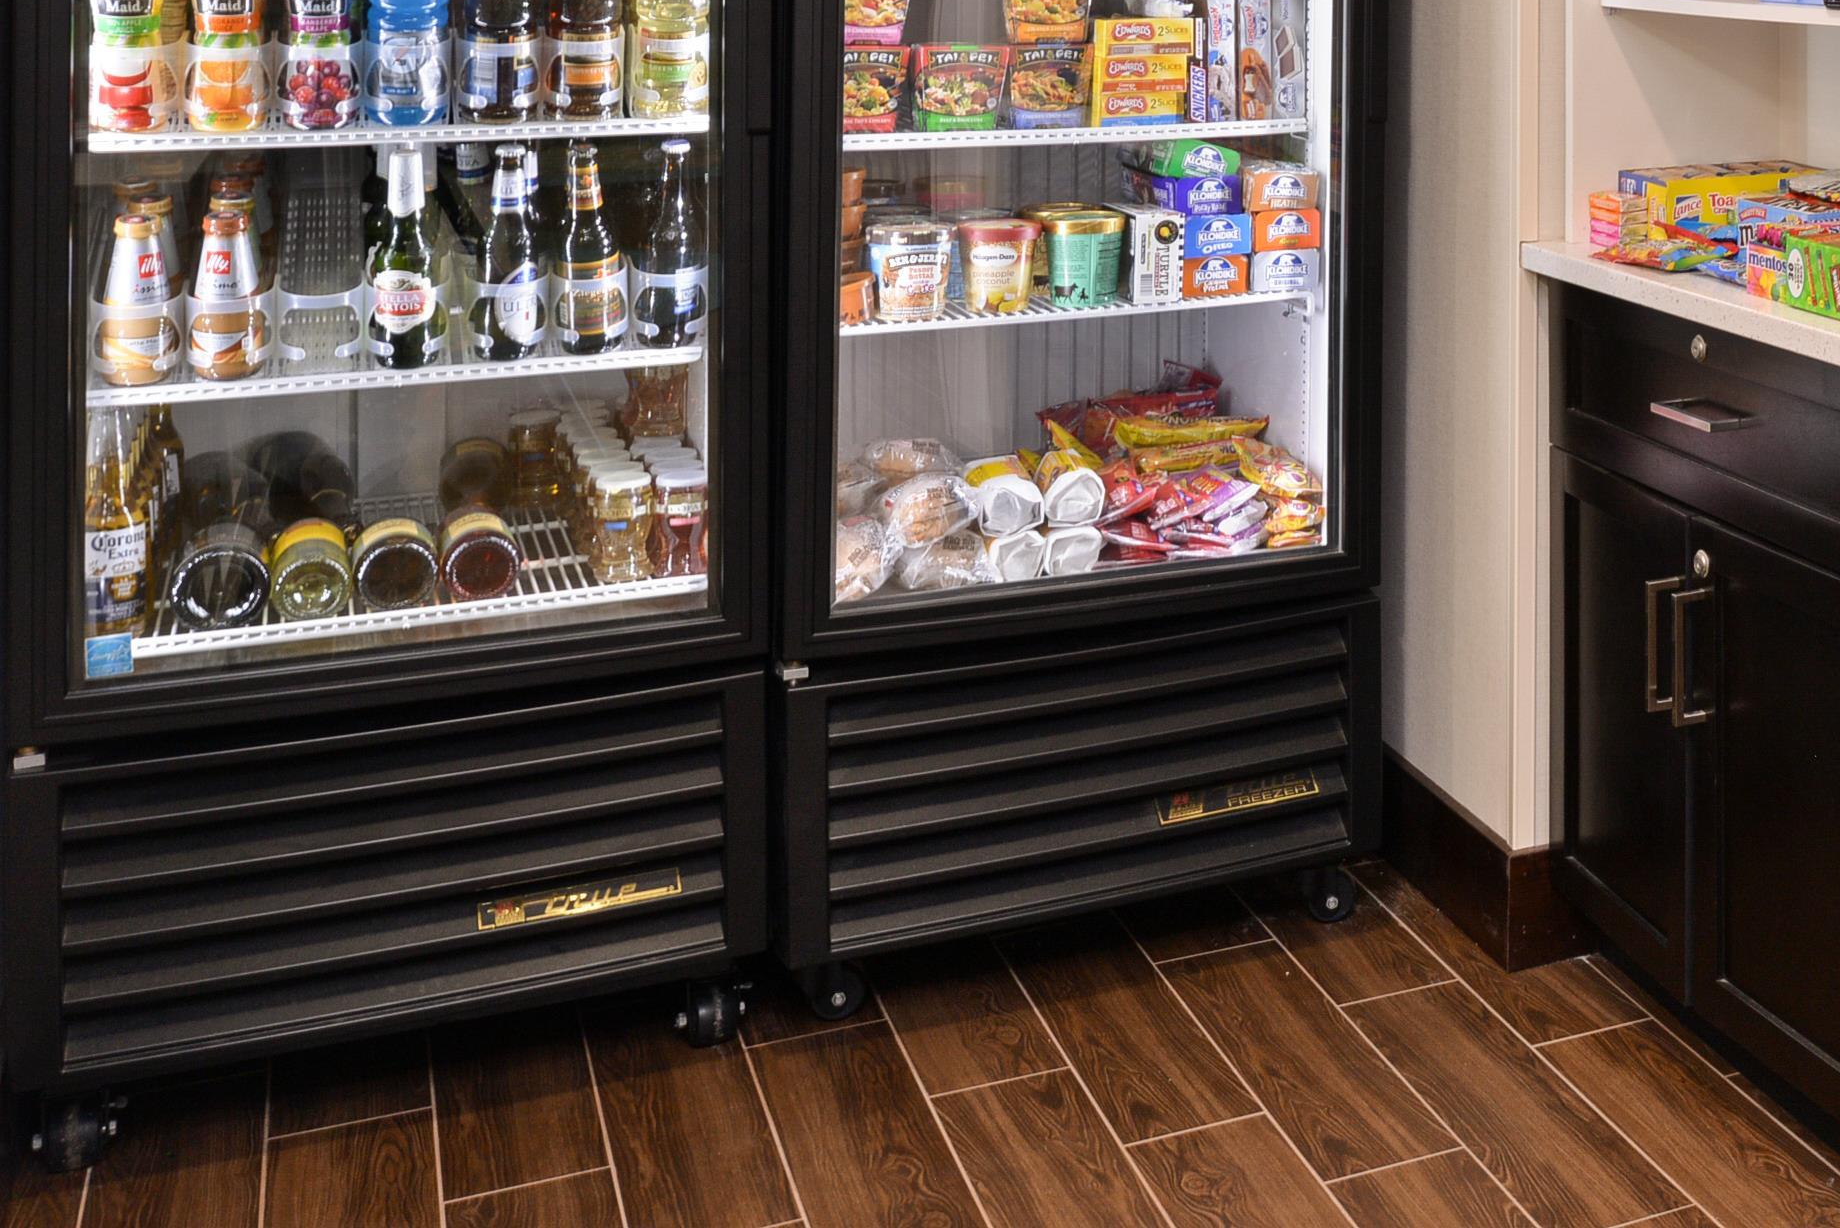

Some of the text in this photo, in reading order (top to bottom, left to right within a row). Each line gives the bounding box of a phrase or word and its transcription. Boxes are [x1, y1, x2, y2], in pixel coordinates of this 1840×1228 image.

[105, 0, 140, 12] Maid
[1114, 23, 1152, 36] EDWARDS
[1157, 26, 1164, 36] 2
[935, 53, 992, 63] TAI PEI
[1023, 50, 1078, 61] TAI PEI
[1108, 59, 1146, 72] EDWARDS
[1151, 62, 1158, 72] 2
[1191, 65, 1205, 123] SNICKERS
[1107, 96, 1145, 109] EDWARDS
[1184, 154, 1226, 174] KLONDIKE
[1188, 188, 1232, 204] KLONDIKE
[1264, 183, 1305, 201] KLONDIKE
[1270, 199, 1298, 208] HEATH
[1673, 196, 1701, 220] Lance
[1198, 229, 1240, 245] KLONDIKE
[1268, 223, 1310, 240] KLONDIKE
[1203, 243, 1233, 254] OREO
[141, 253, 161, 274] illy
[1748, 251, 1786, 272] mentos
[1155, 245, 1170, 297] TURTLE
[1194, 268, 1238, 285] KLONDIKE
[1266, 264, 1307, 279] KLONDIKE
[108, 547, 139, 560] Extra
[1228, 784, 1307, 807] FREEZER
